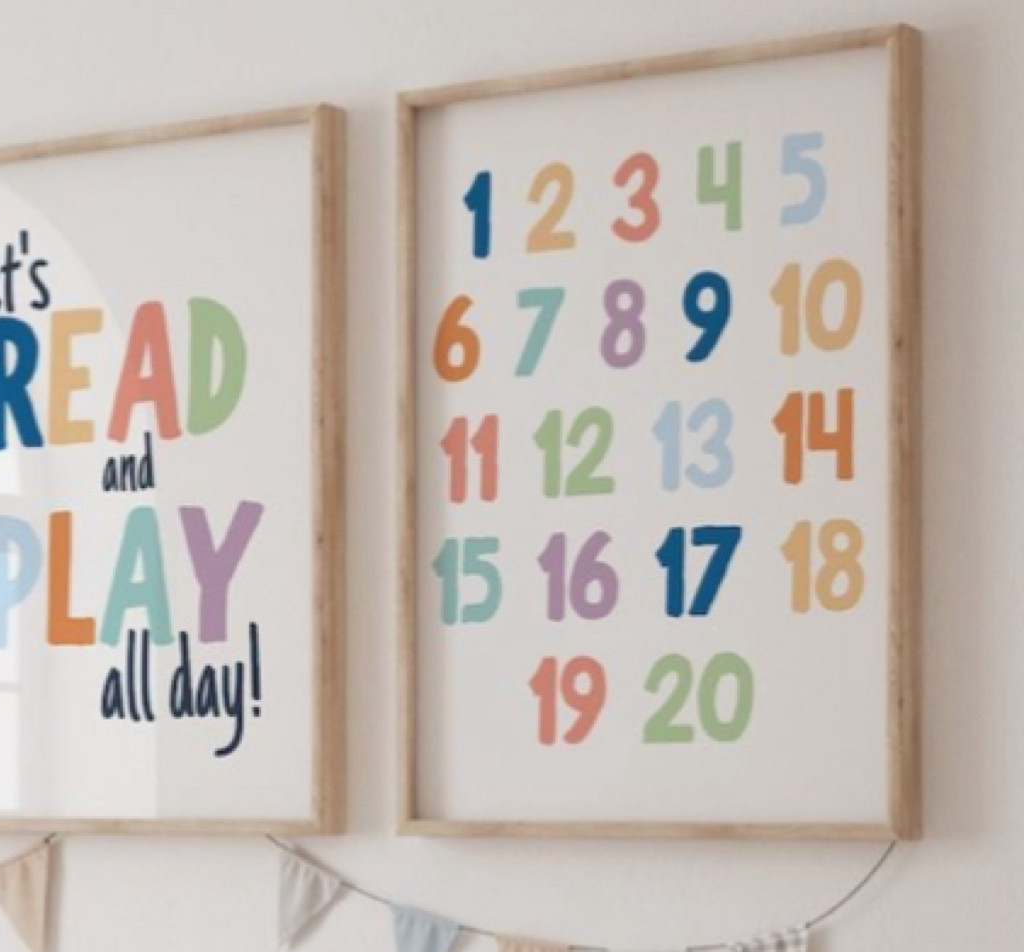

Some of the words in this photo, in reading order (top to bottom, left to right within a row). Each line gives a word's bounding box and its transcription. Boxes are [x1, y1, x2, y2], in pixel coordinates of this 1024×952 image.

[463, 170, 492, 259] 1
[525, 162, 576, 254] 2
[611, 151, 661, 243] 3
[696, 140, 743, 231] 4
[779, 131, 827, 228] 5
[432, 294, 482, 382] 6
[513, 287, 566, 377] 7
[600, 279, 646, 369] 8
[682, 271, 732, 363] 9
[770, 258, 863, 356] 10
[103, 431, 155, 492] and
[440, 413, 499, 504] 11
[533, 406, 616, 498] 12
[651, 398, 734, 492] 13
[772, 388, 855, 485] 14
[432, 536, 503, 626] 15
[537, 529, 620, 622] 16
[655, 525, 743, 618] 17
[781, 518, 865, 614] 18
[101, 629, 156, 722] all
[169, 621, 262, 757] day!
[528, 655, 607, 747] 19
[641, 651, 755, 745] 20
